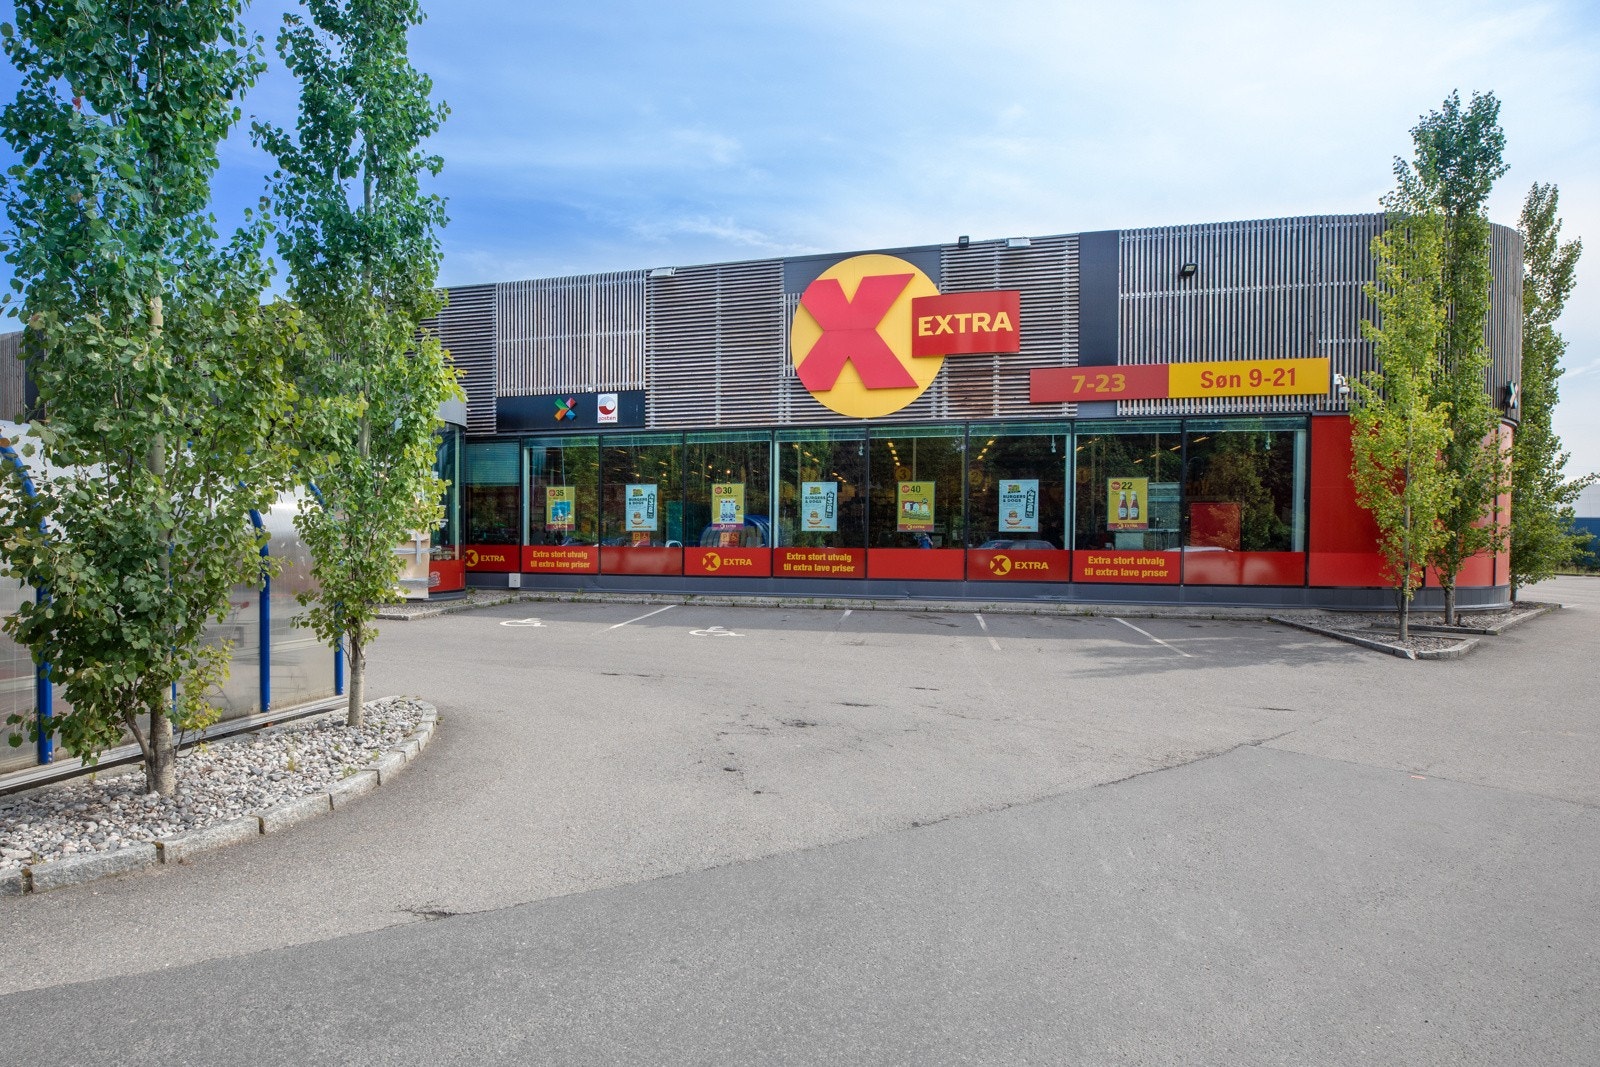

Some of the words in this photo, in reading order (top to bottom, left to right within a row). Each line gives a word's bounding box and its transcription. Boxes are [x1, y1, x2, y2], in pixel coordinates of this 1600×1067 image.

[918, 312, 1013, 337] EXTRA
[1200, 371, 1241, 388] Søn
[1249, 368, 1296, 387] 9-21
[1071, 374, 1126, 393] 7-23
[723, 486, 732, 494] 30
[911, 485, 921, 493] 40
[1122, 482, 1133, 490] 22
[480, 554, 505, 562] EXTRA
[533, 550, 549, 558] Extra
[567, 551, 588, 559] utvalg
[786, 552, 806, 560] Extra
[828, 553, 851, 562] utvalg
[571, 561, 590, 569] priser
[1015, 561, 1049, 569] EXTRA
[1088, 556, 1111, 564] Extra
[1113, 557, 1135, 565] stort
[1137, 557, 1165, 566] utvalg
[783, 563, 791, 571] til
[832, 565, 855, 573] priser
[1084, 568, 1094, 576] til
[1095, 568, 1118, 576] extra
[1121, 568, 1140, 576] lave
[1141, 569, 1169, 578] priser
